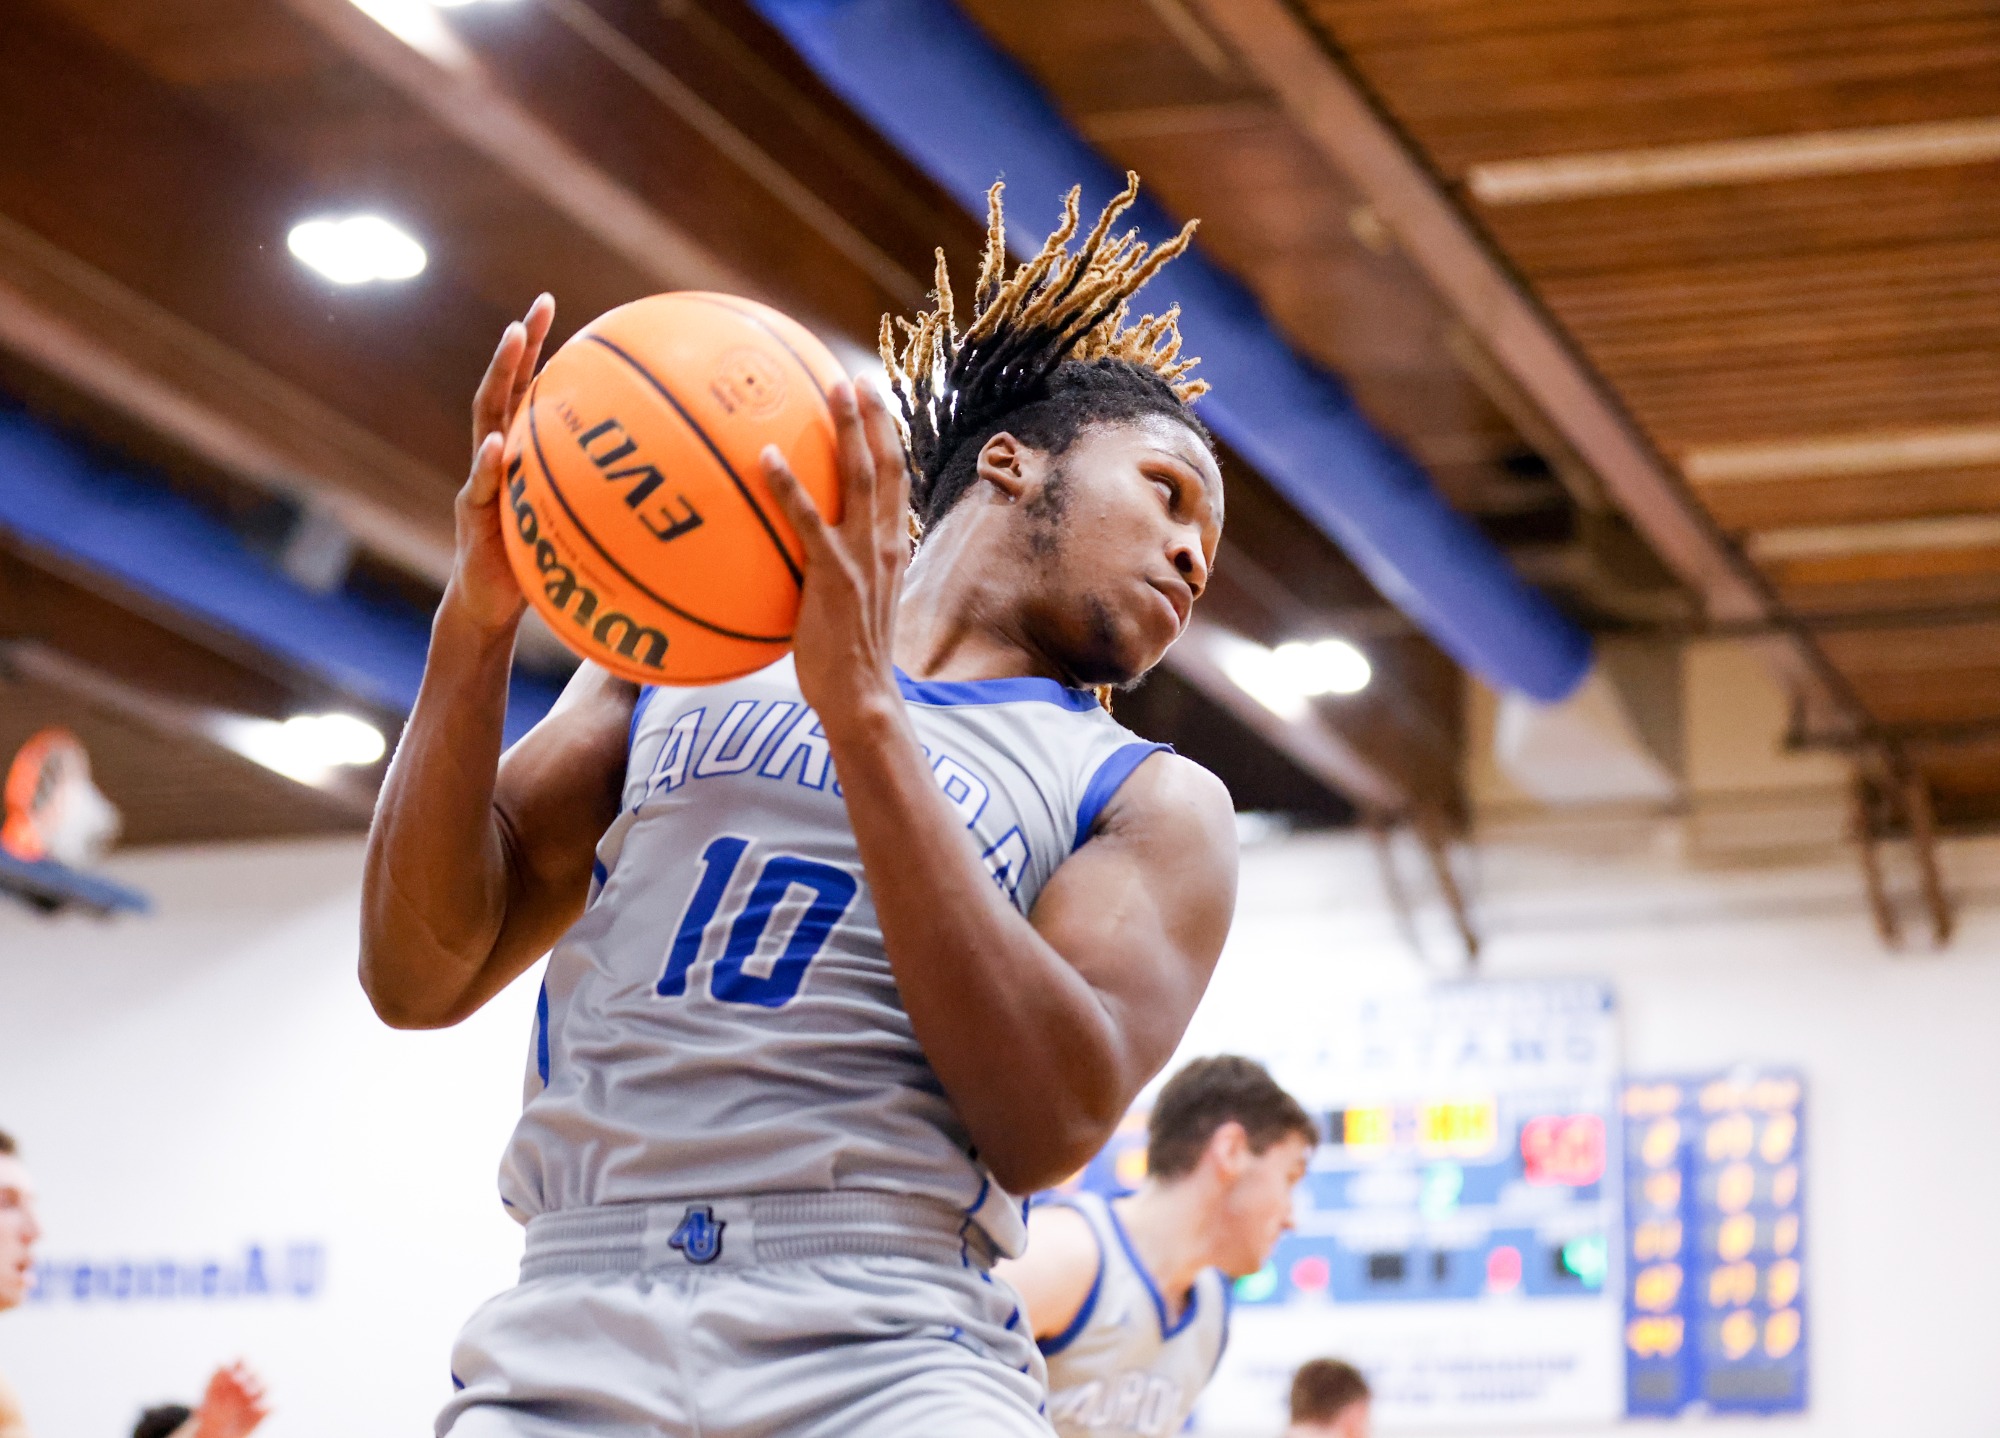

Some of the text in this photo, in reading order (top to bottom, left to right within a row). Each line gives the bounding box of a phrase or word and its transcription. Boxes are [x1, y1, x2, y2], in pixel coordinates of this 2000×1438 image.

[577, 417, 704, 543] EVO
[632, 700, 1031, 911] AURRA
[653, 832, 860, 1010] 10
[668, 1205, 726, 1266] AU
